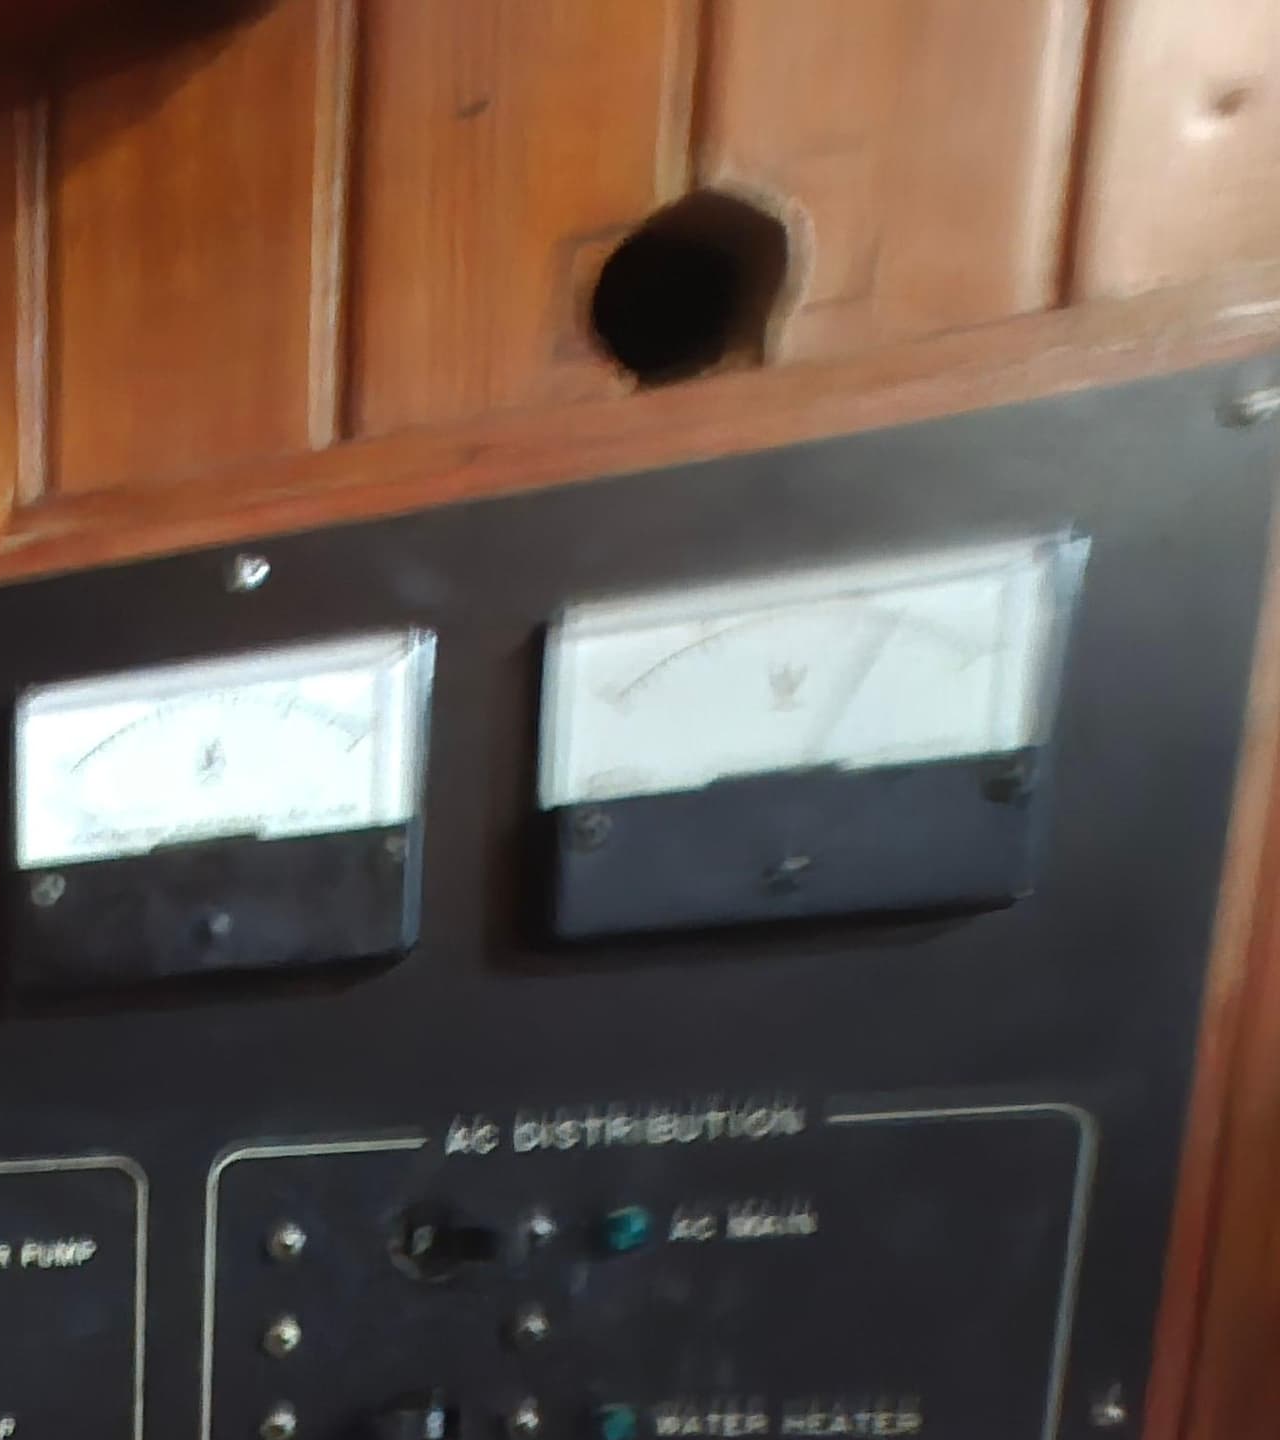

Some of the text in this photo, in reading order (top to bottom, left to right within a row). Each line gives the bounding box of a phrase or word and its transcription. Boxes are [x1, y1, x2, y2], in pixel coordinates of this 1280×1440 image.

[444, 1104, 808, 1156] AC DISTRIBUTION
[21, 1236, 98, 1269] PUMP
[656, 1412, 921, 1436] WATER HEATER
